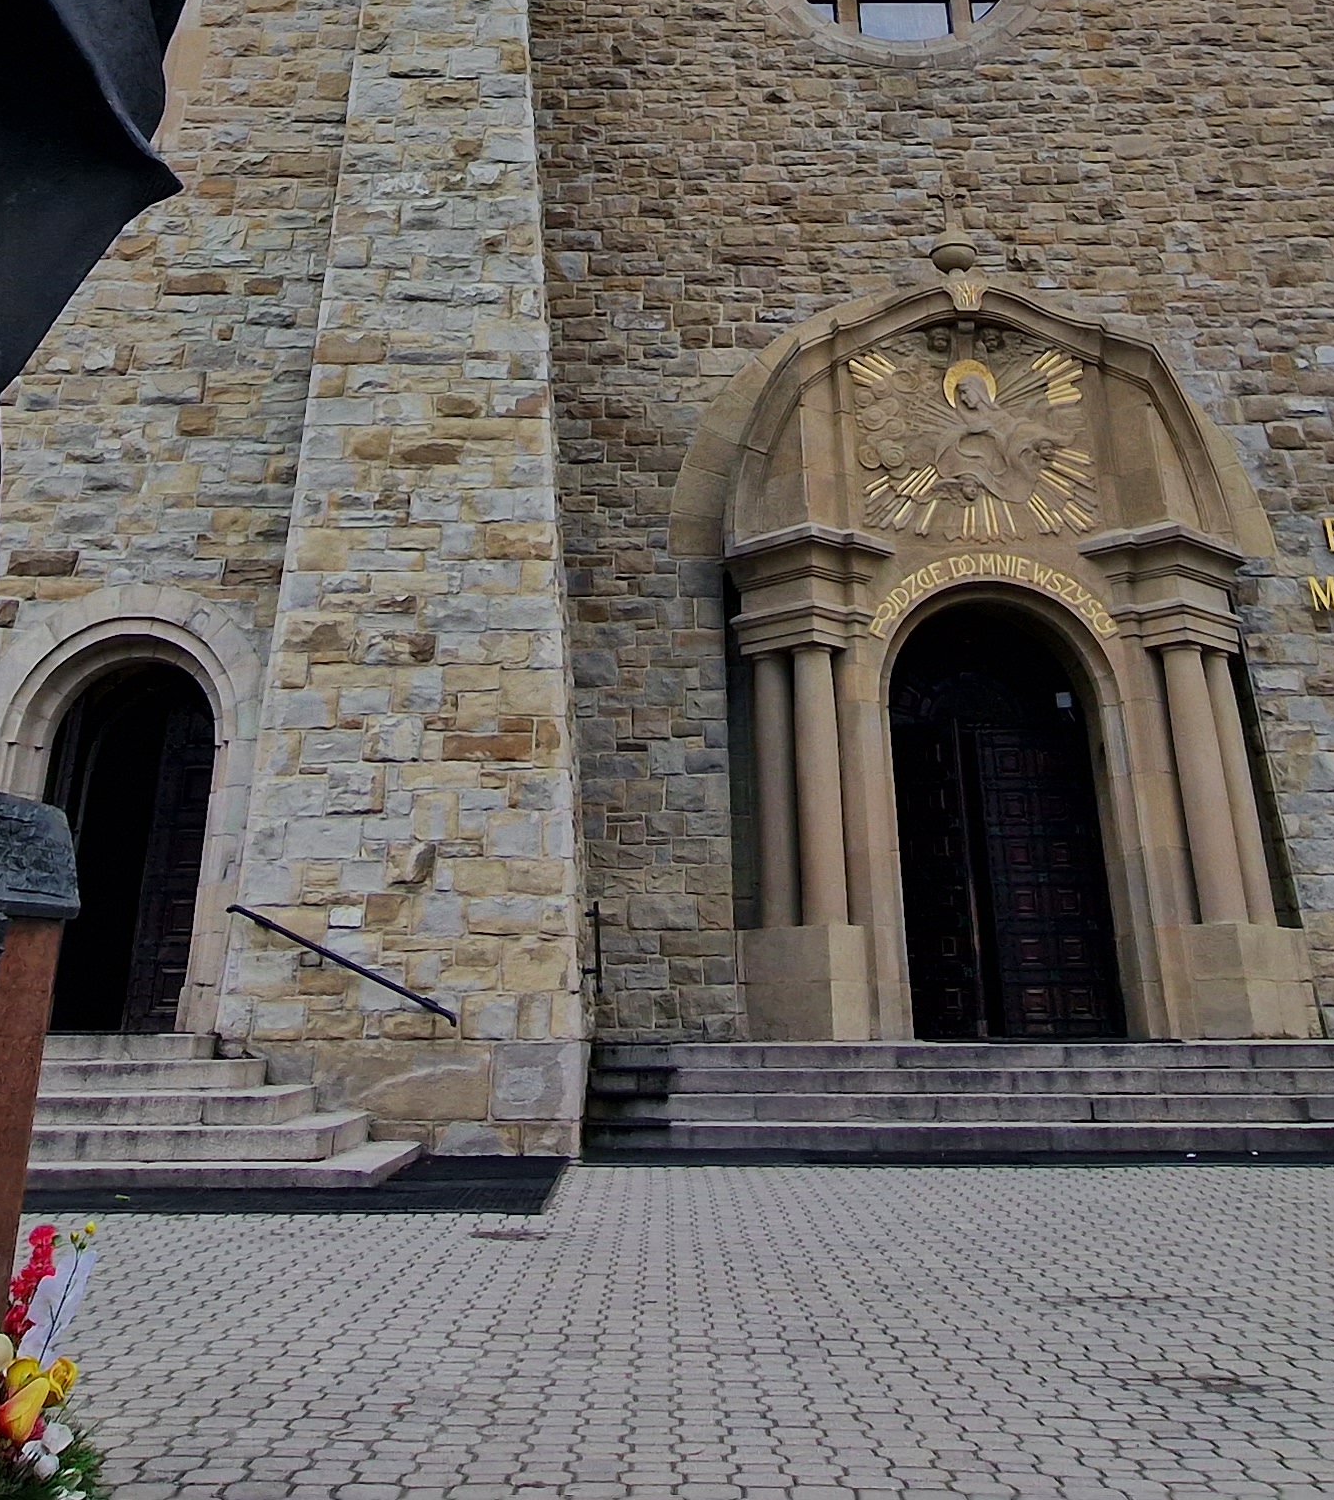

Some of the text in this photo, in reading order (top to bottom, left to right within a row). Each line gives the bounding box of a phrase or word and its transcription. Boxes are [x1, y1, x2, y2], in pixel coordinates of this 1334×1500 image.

[948, 554, 976, 578] DO
[979, 553, 1031, 580] MNIE
[1033, 562, 1119, 633] WSZYSCY
